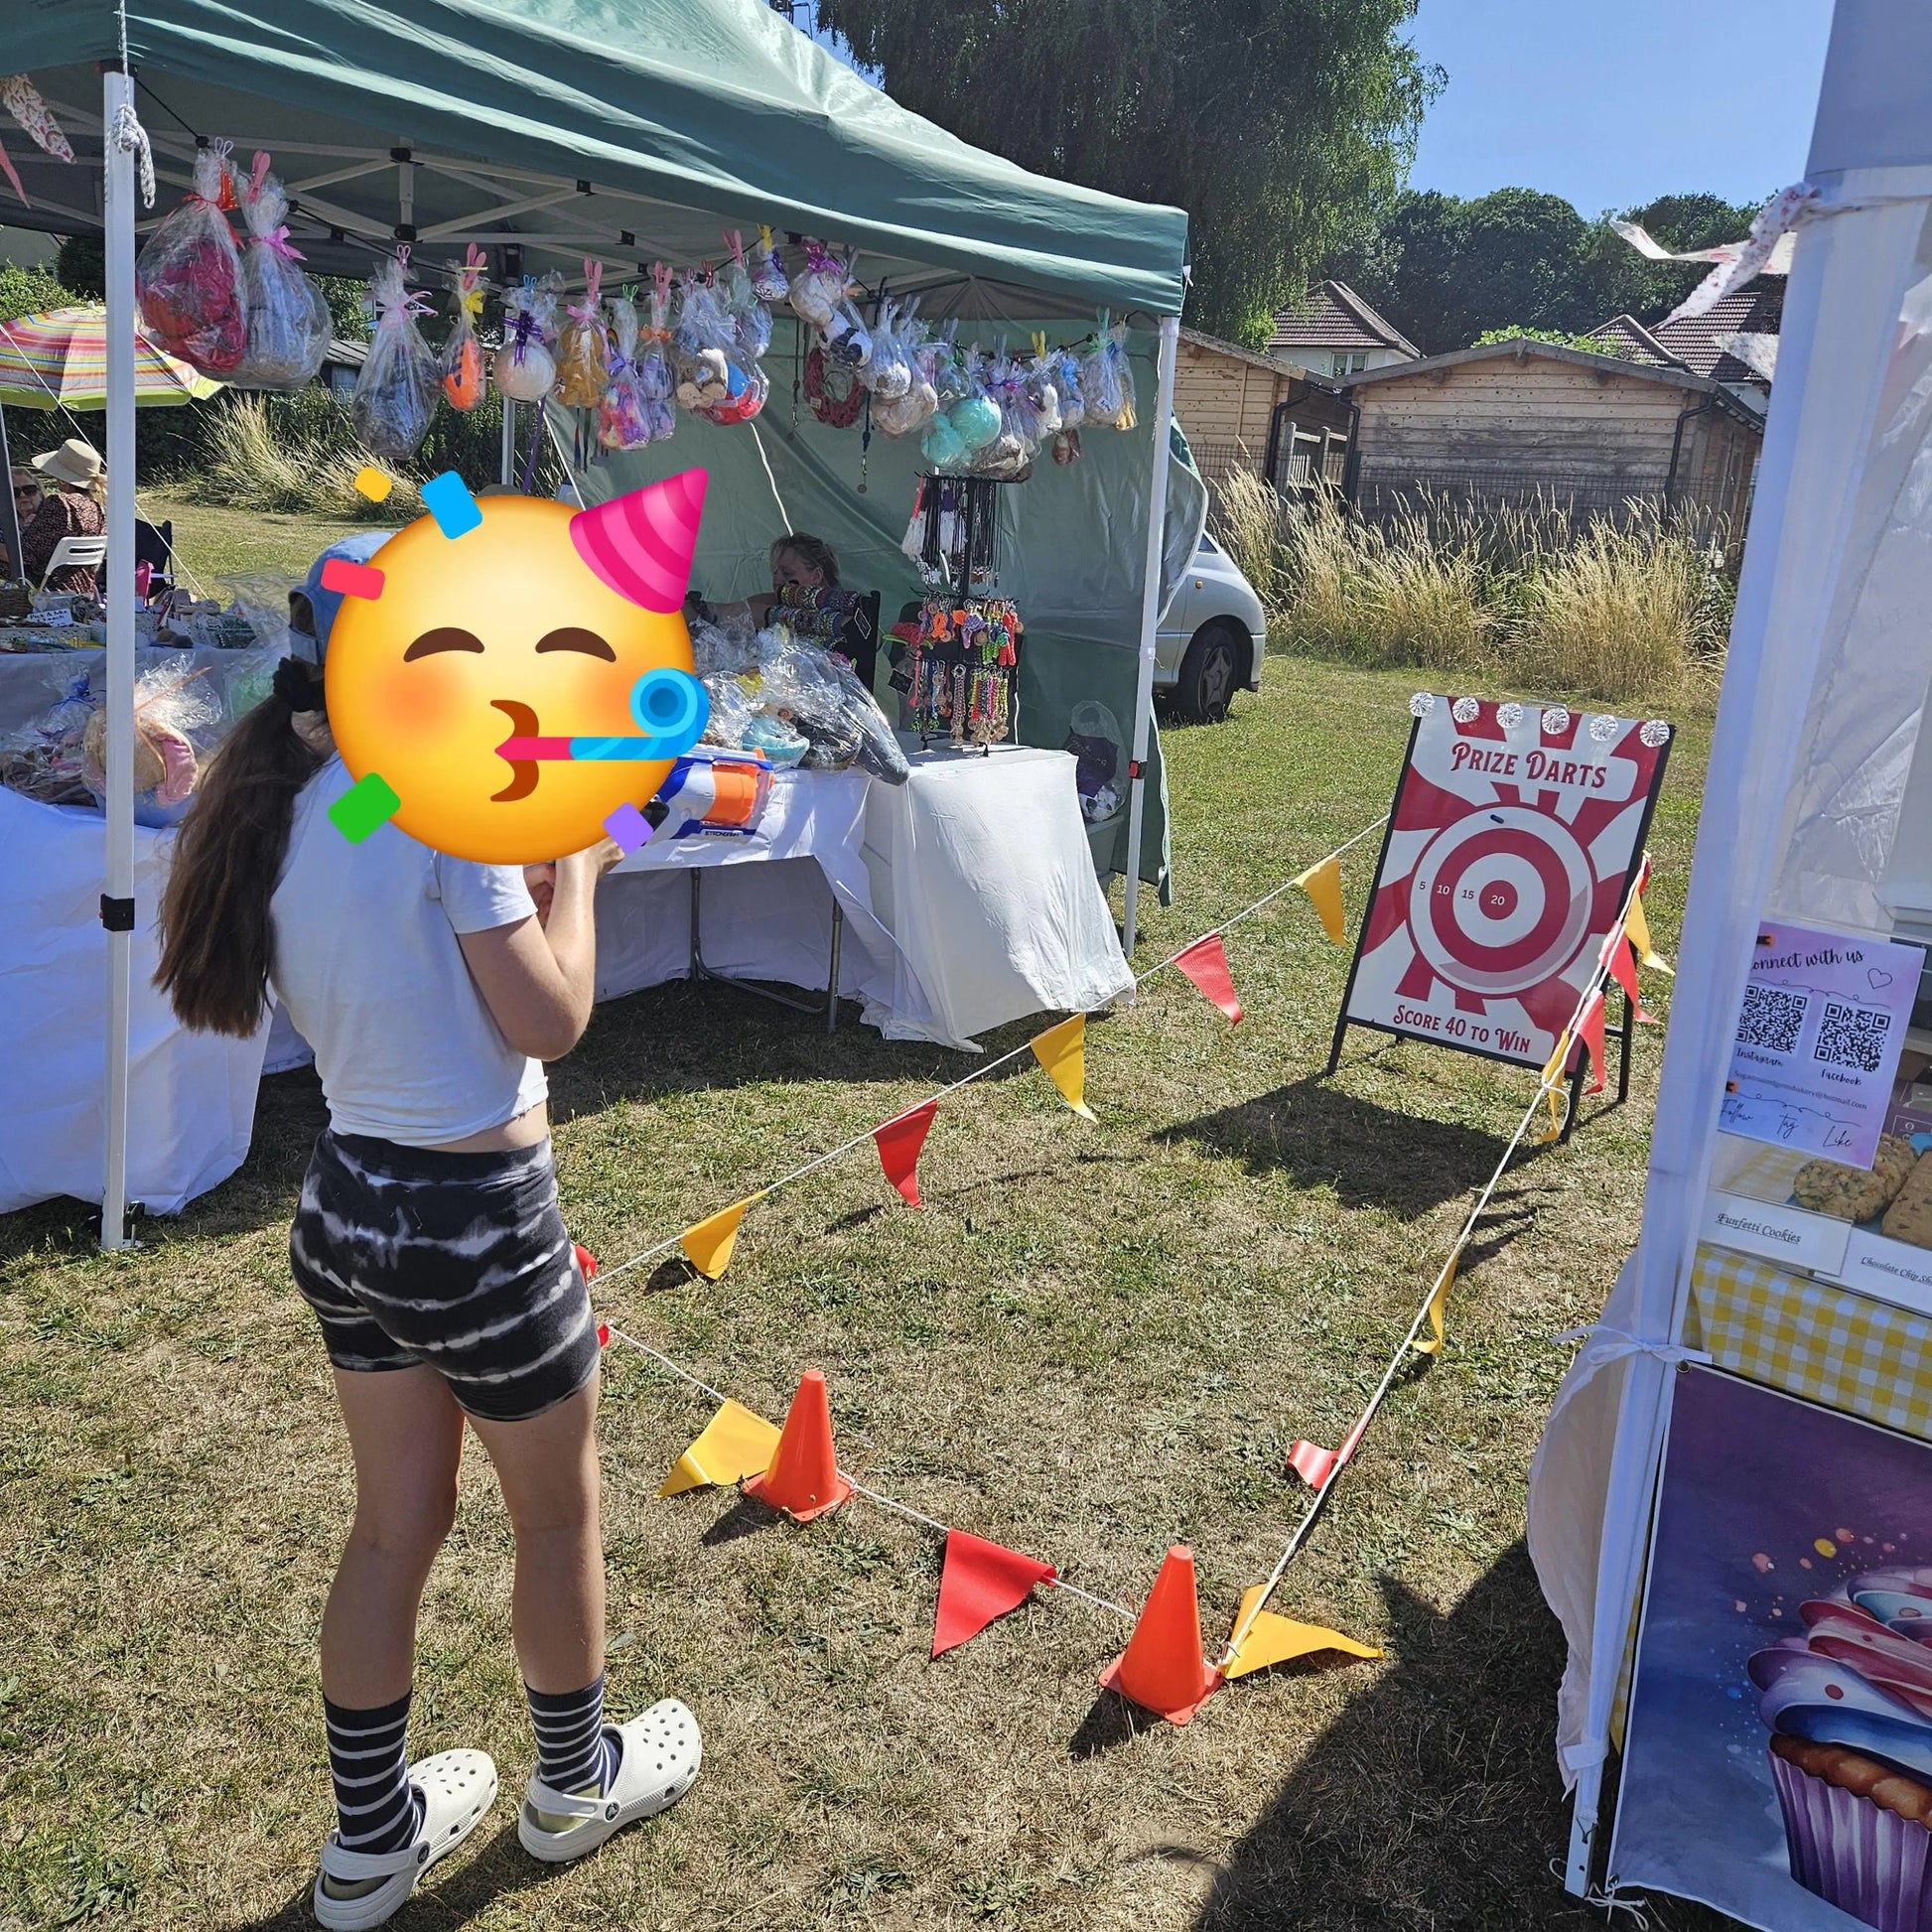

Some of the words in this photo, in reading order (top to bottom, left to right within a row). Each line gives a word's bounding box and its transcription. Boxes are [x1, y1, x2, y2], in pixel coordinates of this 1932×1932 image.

[1450, 742, 1519, 775] PRIZE
[1526, 750, 1607, 789] DARTS
[1419, 881, 1427, 891] 5
[1437, 885, 1450, 895] 10
[1461, 890, 1474, 899] 15
[1490, 895, 1505, 905] 20
[1749, 952, 1802, 971] onnect
[1806, 948, 1843, 967] with
[1847, 950, 1865, 964] us
[1393, 1005, 1442, 1031] SCORE
[1445, 1017, 1466, 1036] 40
[1470, 1026, 1489, 1042] TO
[1495, 1028, 1531, 1053] WIN
[1736, 1047, 1784, 1067] Instagram
[1777, 1113, 1798, 1139] Tag
[1823, 1125, 1853, 1147] Like
[1717, 1213, 1761, 1232] Funfetti
[1762, 1225, 1802, 1244] Cookies
[1899, 1269, 1919, 1282] Chip
